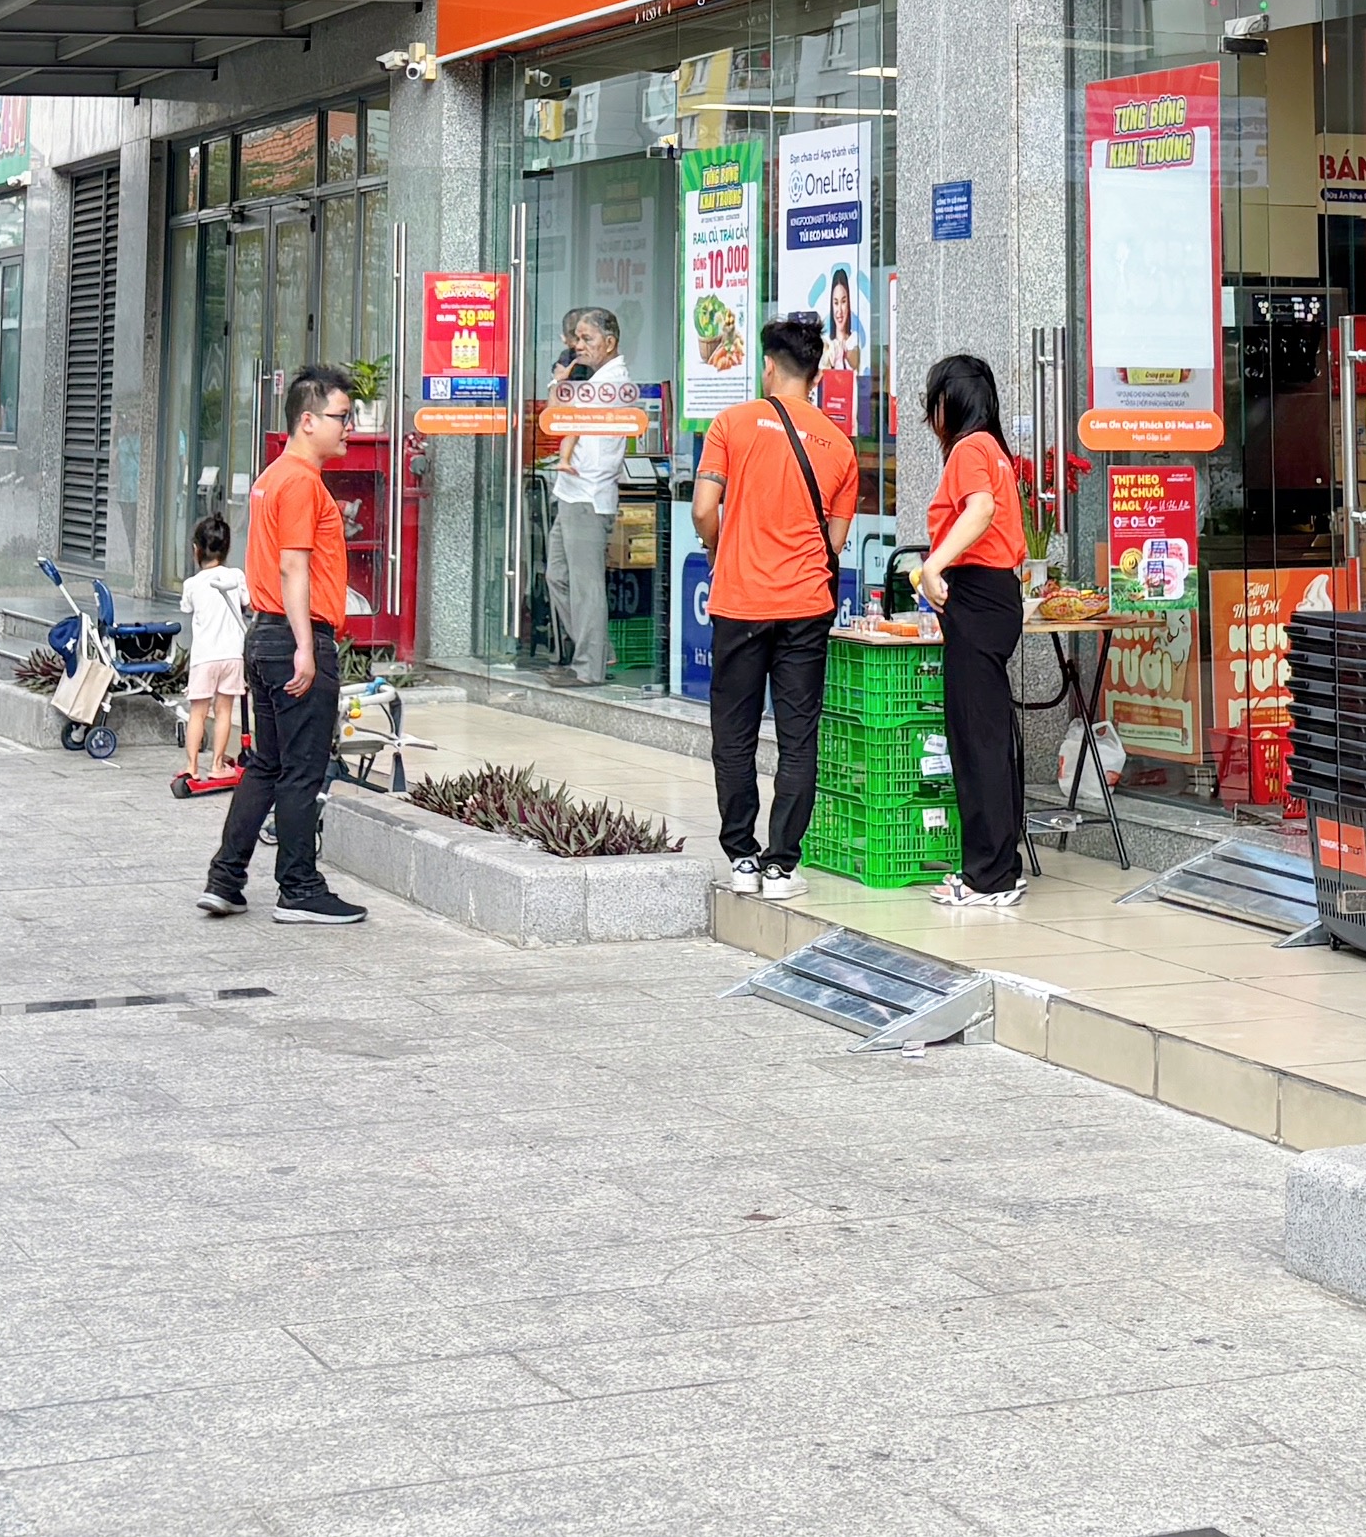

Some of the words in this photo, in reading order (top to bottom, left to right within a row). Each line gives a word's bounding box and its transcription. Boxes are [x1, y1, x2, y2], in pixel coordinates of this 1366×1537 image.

[1109, 141, 1138, 168] KHAI
[1141, 132, 1192, 165] TRƯƠNG
[708, 244, 749, 289] 10.000
[457, 309, 495, 326] 39.000
[1112, 474, 1136, 487] THỊT
[1137, 474, 1160, 486] HEO
[1112, 500, 1142, 512] HAGL
[1108, 644, 1173, 693] TƯƠI
